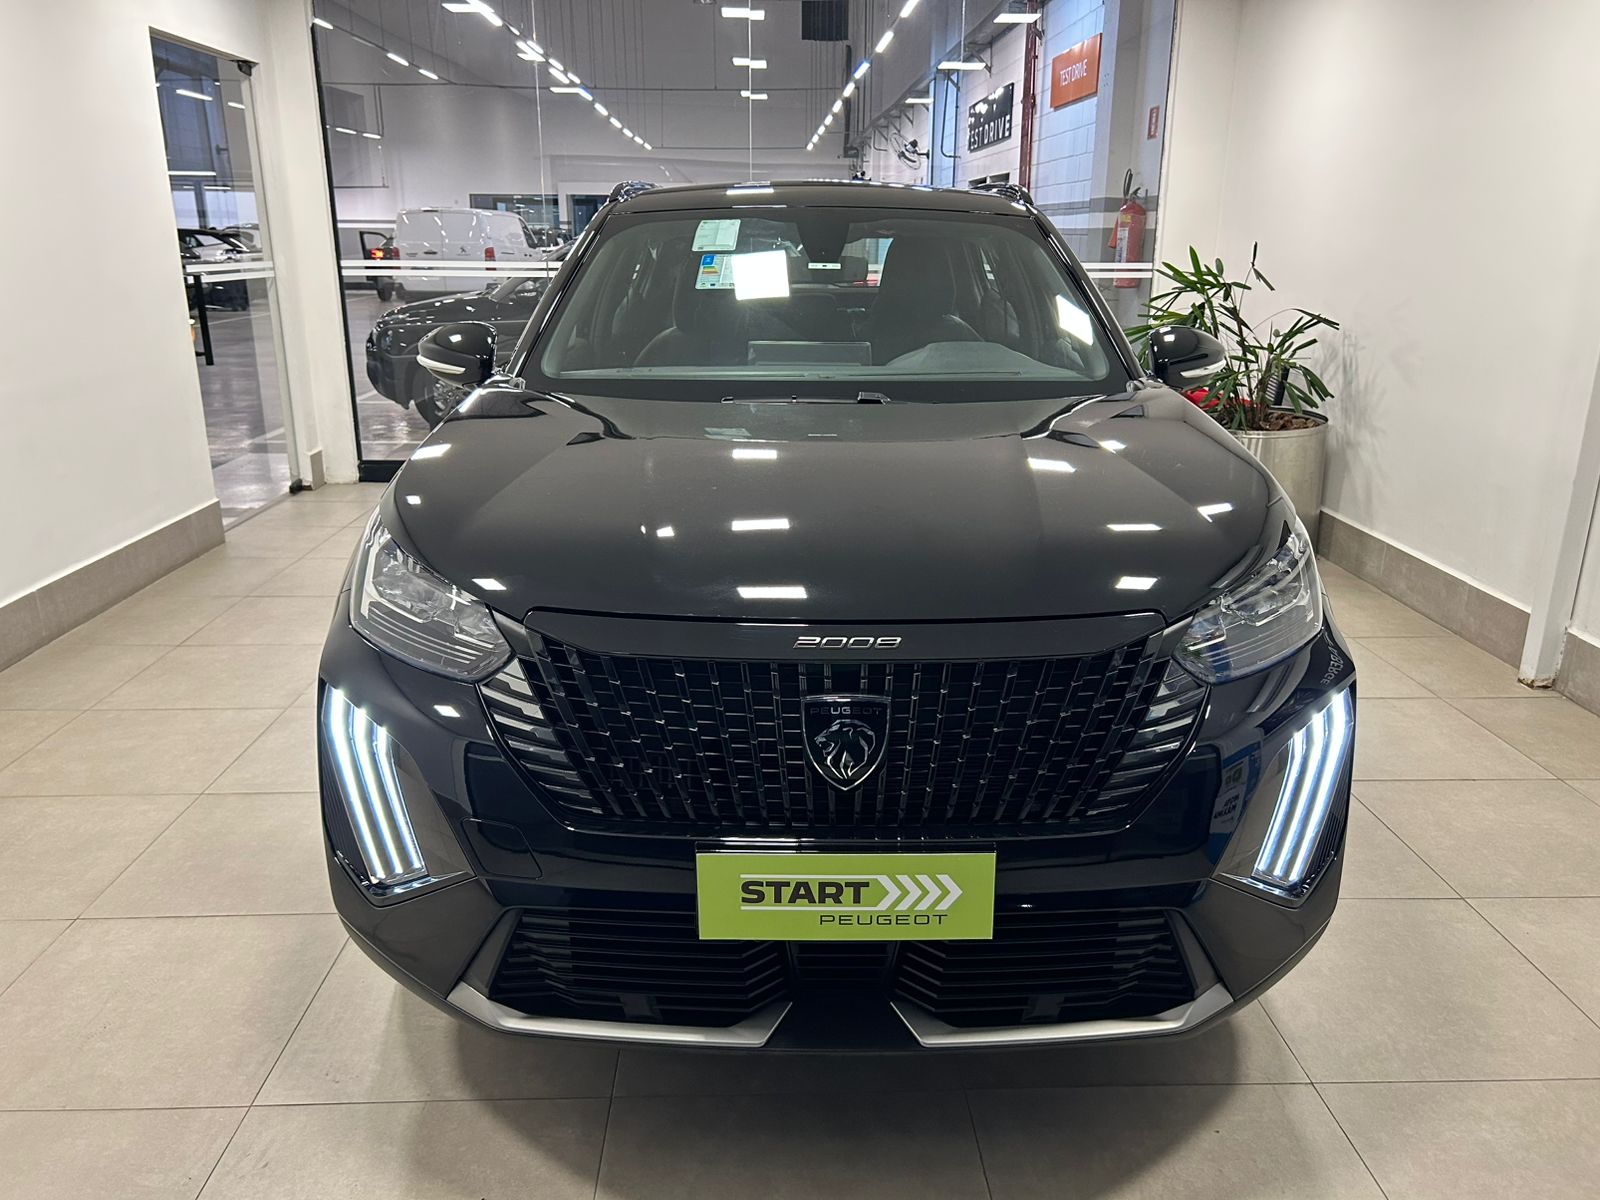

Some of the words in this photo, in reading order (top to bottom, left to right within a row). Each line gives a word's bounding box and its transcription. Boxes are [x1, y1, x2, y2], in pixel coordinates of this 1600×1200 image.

[1060, 66, 1072, 86] TEST
[1072, 59, 1088, 82] DRIVE
[984, 114, 1011, 145] DRIVE
[793, 636, 903, 649] 2008
[810, 706, 882, 716] PEUGEOT
[741, 880, 870, 905] START
[819, 914, 948, 926] PEUGEOT
